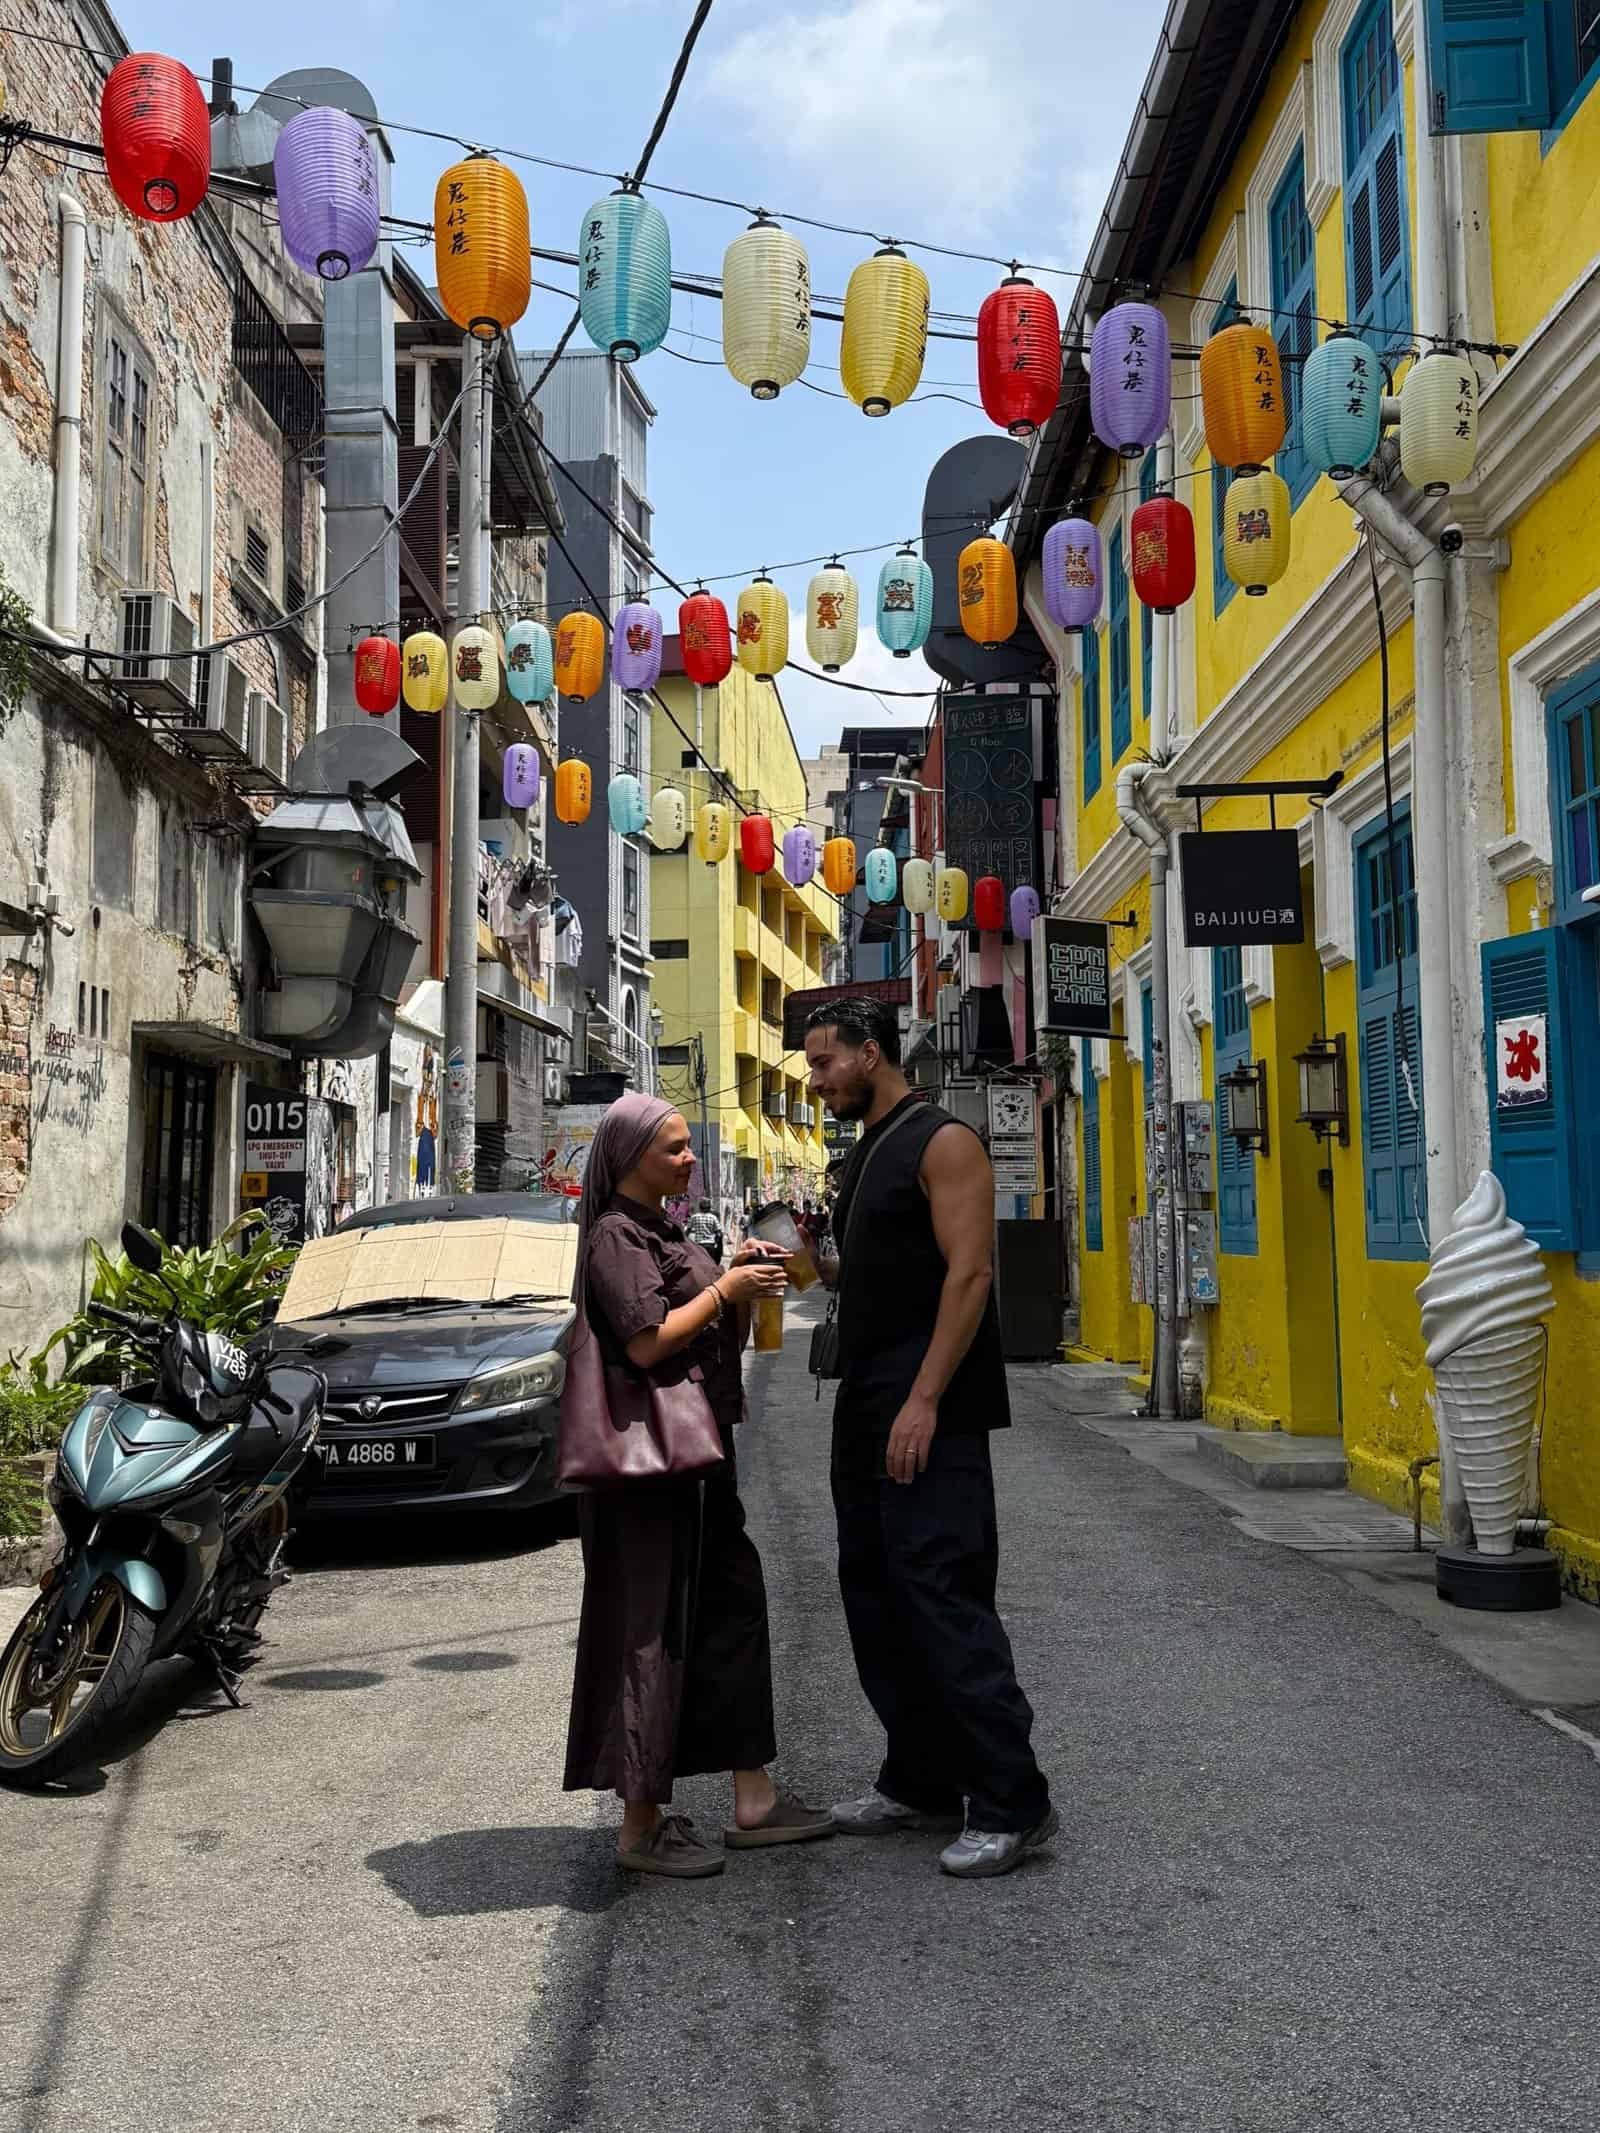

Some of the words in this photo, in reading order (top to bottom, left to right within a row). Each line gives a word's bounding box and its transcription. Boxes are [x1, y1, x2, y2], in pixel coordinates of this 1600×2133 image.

[1120, 324, 1148, 393] 鬼仔巷
[1254, 346, 1276, 412] 鬼仔巷
[1345, 354, 1370, 418] 鬼仔巷
[1453, 376, 1473, 440] 鬼仔巷
[1049, 943, 1106, 966] CON
[1048, 963, 1106, 986] CUB
[1050, 983, 1107, 1006] INE
[246, 1102, 305, 1134] 0115
[258, 1151, 292, 1161] SHUT-OFF
[262, 1141, 303, 1150] EMERGENCY
[264, 1160, 286, 1169] VALVE
[218, 1339, 249, 1368] VKE
[215, 1353, 247, 1381] 1783
[347, 1442, 396, 1465] 4866
[404, 1441, 417, 1462] W
